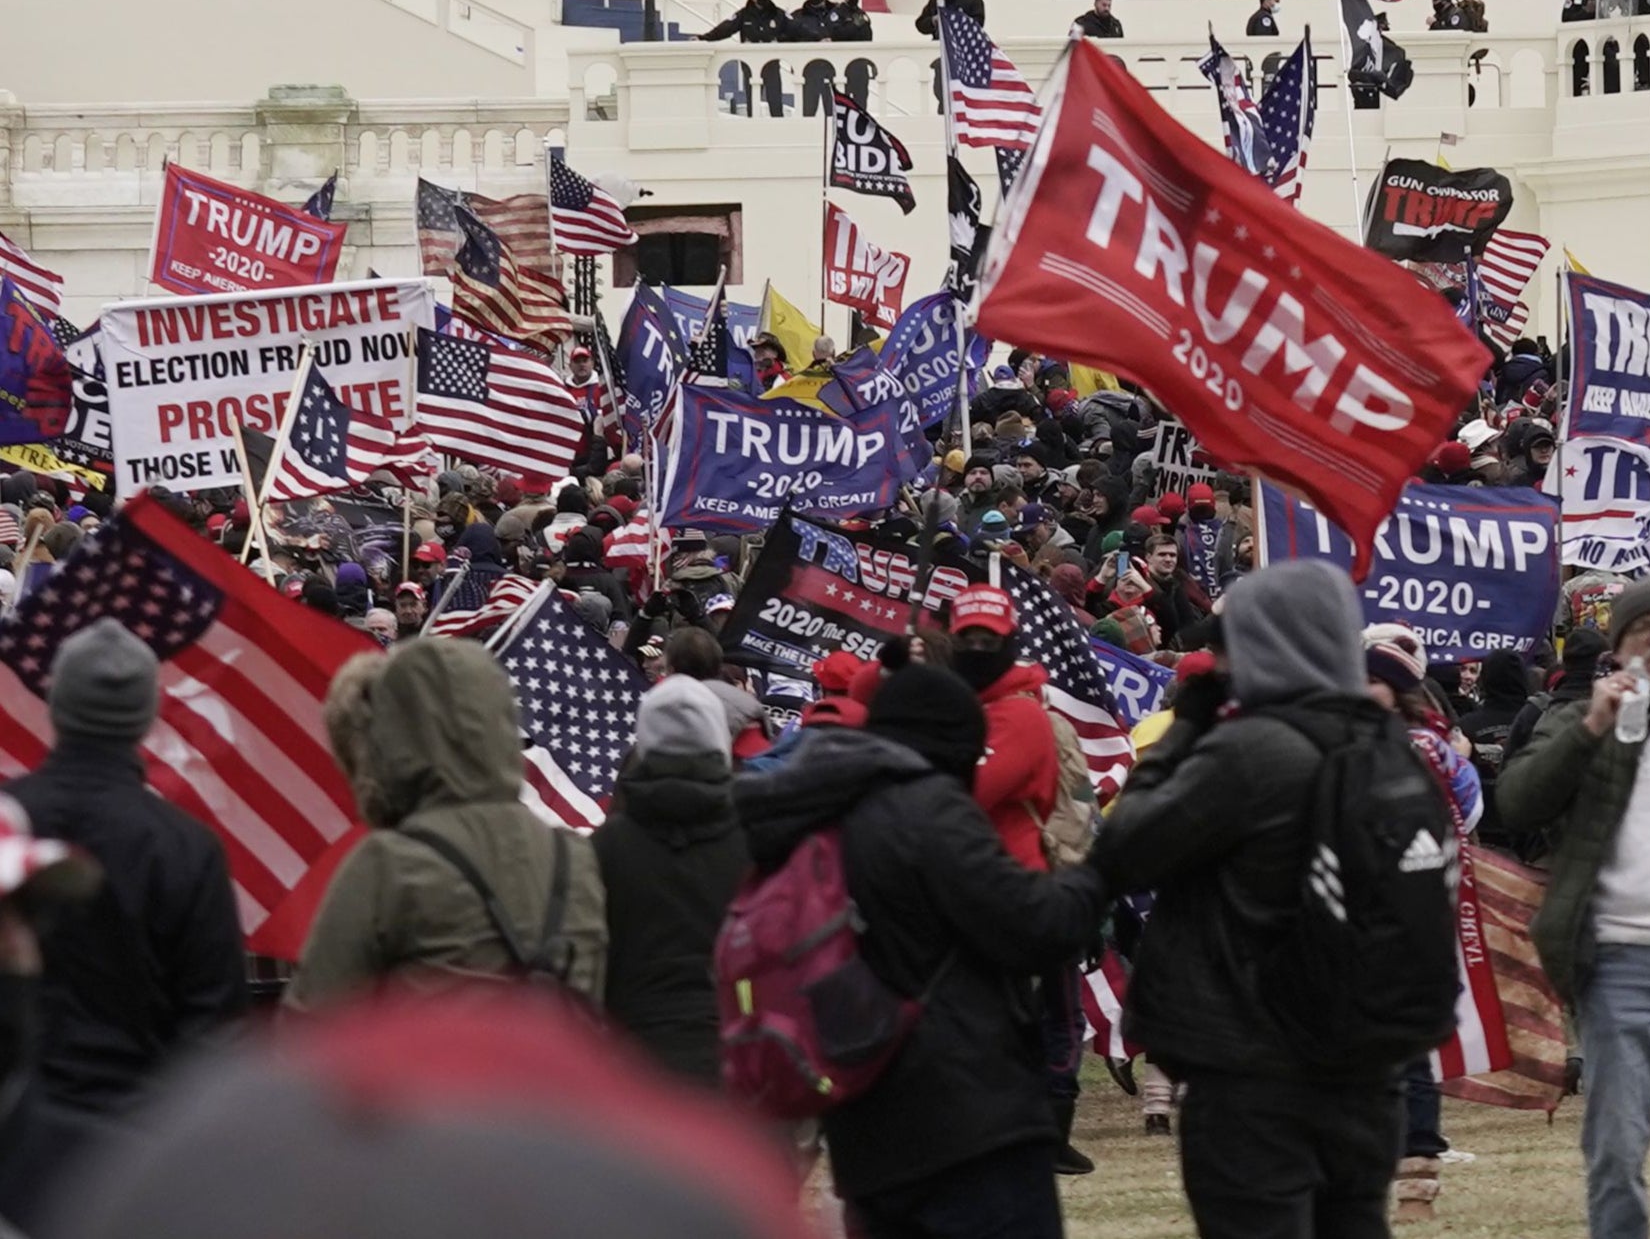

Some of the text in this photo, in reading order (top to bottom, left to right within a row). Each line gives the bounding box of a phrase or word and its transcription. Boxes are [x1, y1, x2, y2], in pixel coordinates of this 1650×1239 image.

[1387, 175, 1424, 191] GUN
[183, 189, 321, 264] TRUMP
[170, 260, 253, 292] KEEP AMERIC
[208, 246, 274, 282] -2020-
[830, 269, 848, 294] IS
[1084, 144, 1415, 436] TRUMP
[135, 286, 402, 347] INVESTIGATE
[116, 349, 249, 388] ELECTION
[259, 338, 351, 373] FRAUD
[1171, 328, 1243, 412] 2020
[1582, 385, 1616, 414] KEEP
[63, 439, 113, 460] VOTING FO
[707, 410, 885, 469] TRUMP
[127, 452, 213, 484] THOSE
[747, 470, 834, 499] -2020-
[694, 495, 741, 513] KEEP
[818, 492, 876, 509] GREAT!
[1579, 538, 1606, 565] NO
[1364, 575, 1491, 616] -2020-
[758, 597, 825, 638] 2020
[823, 622, 845, 640] The
[742, 633, 776, 654] MAKE
[774, 643, 804, 661] THE
